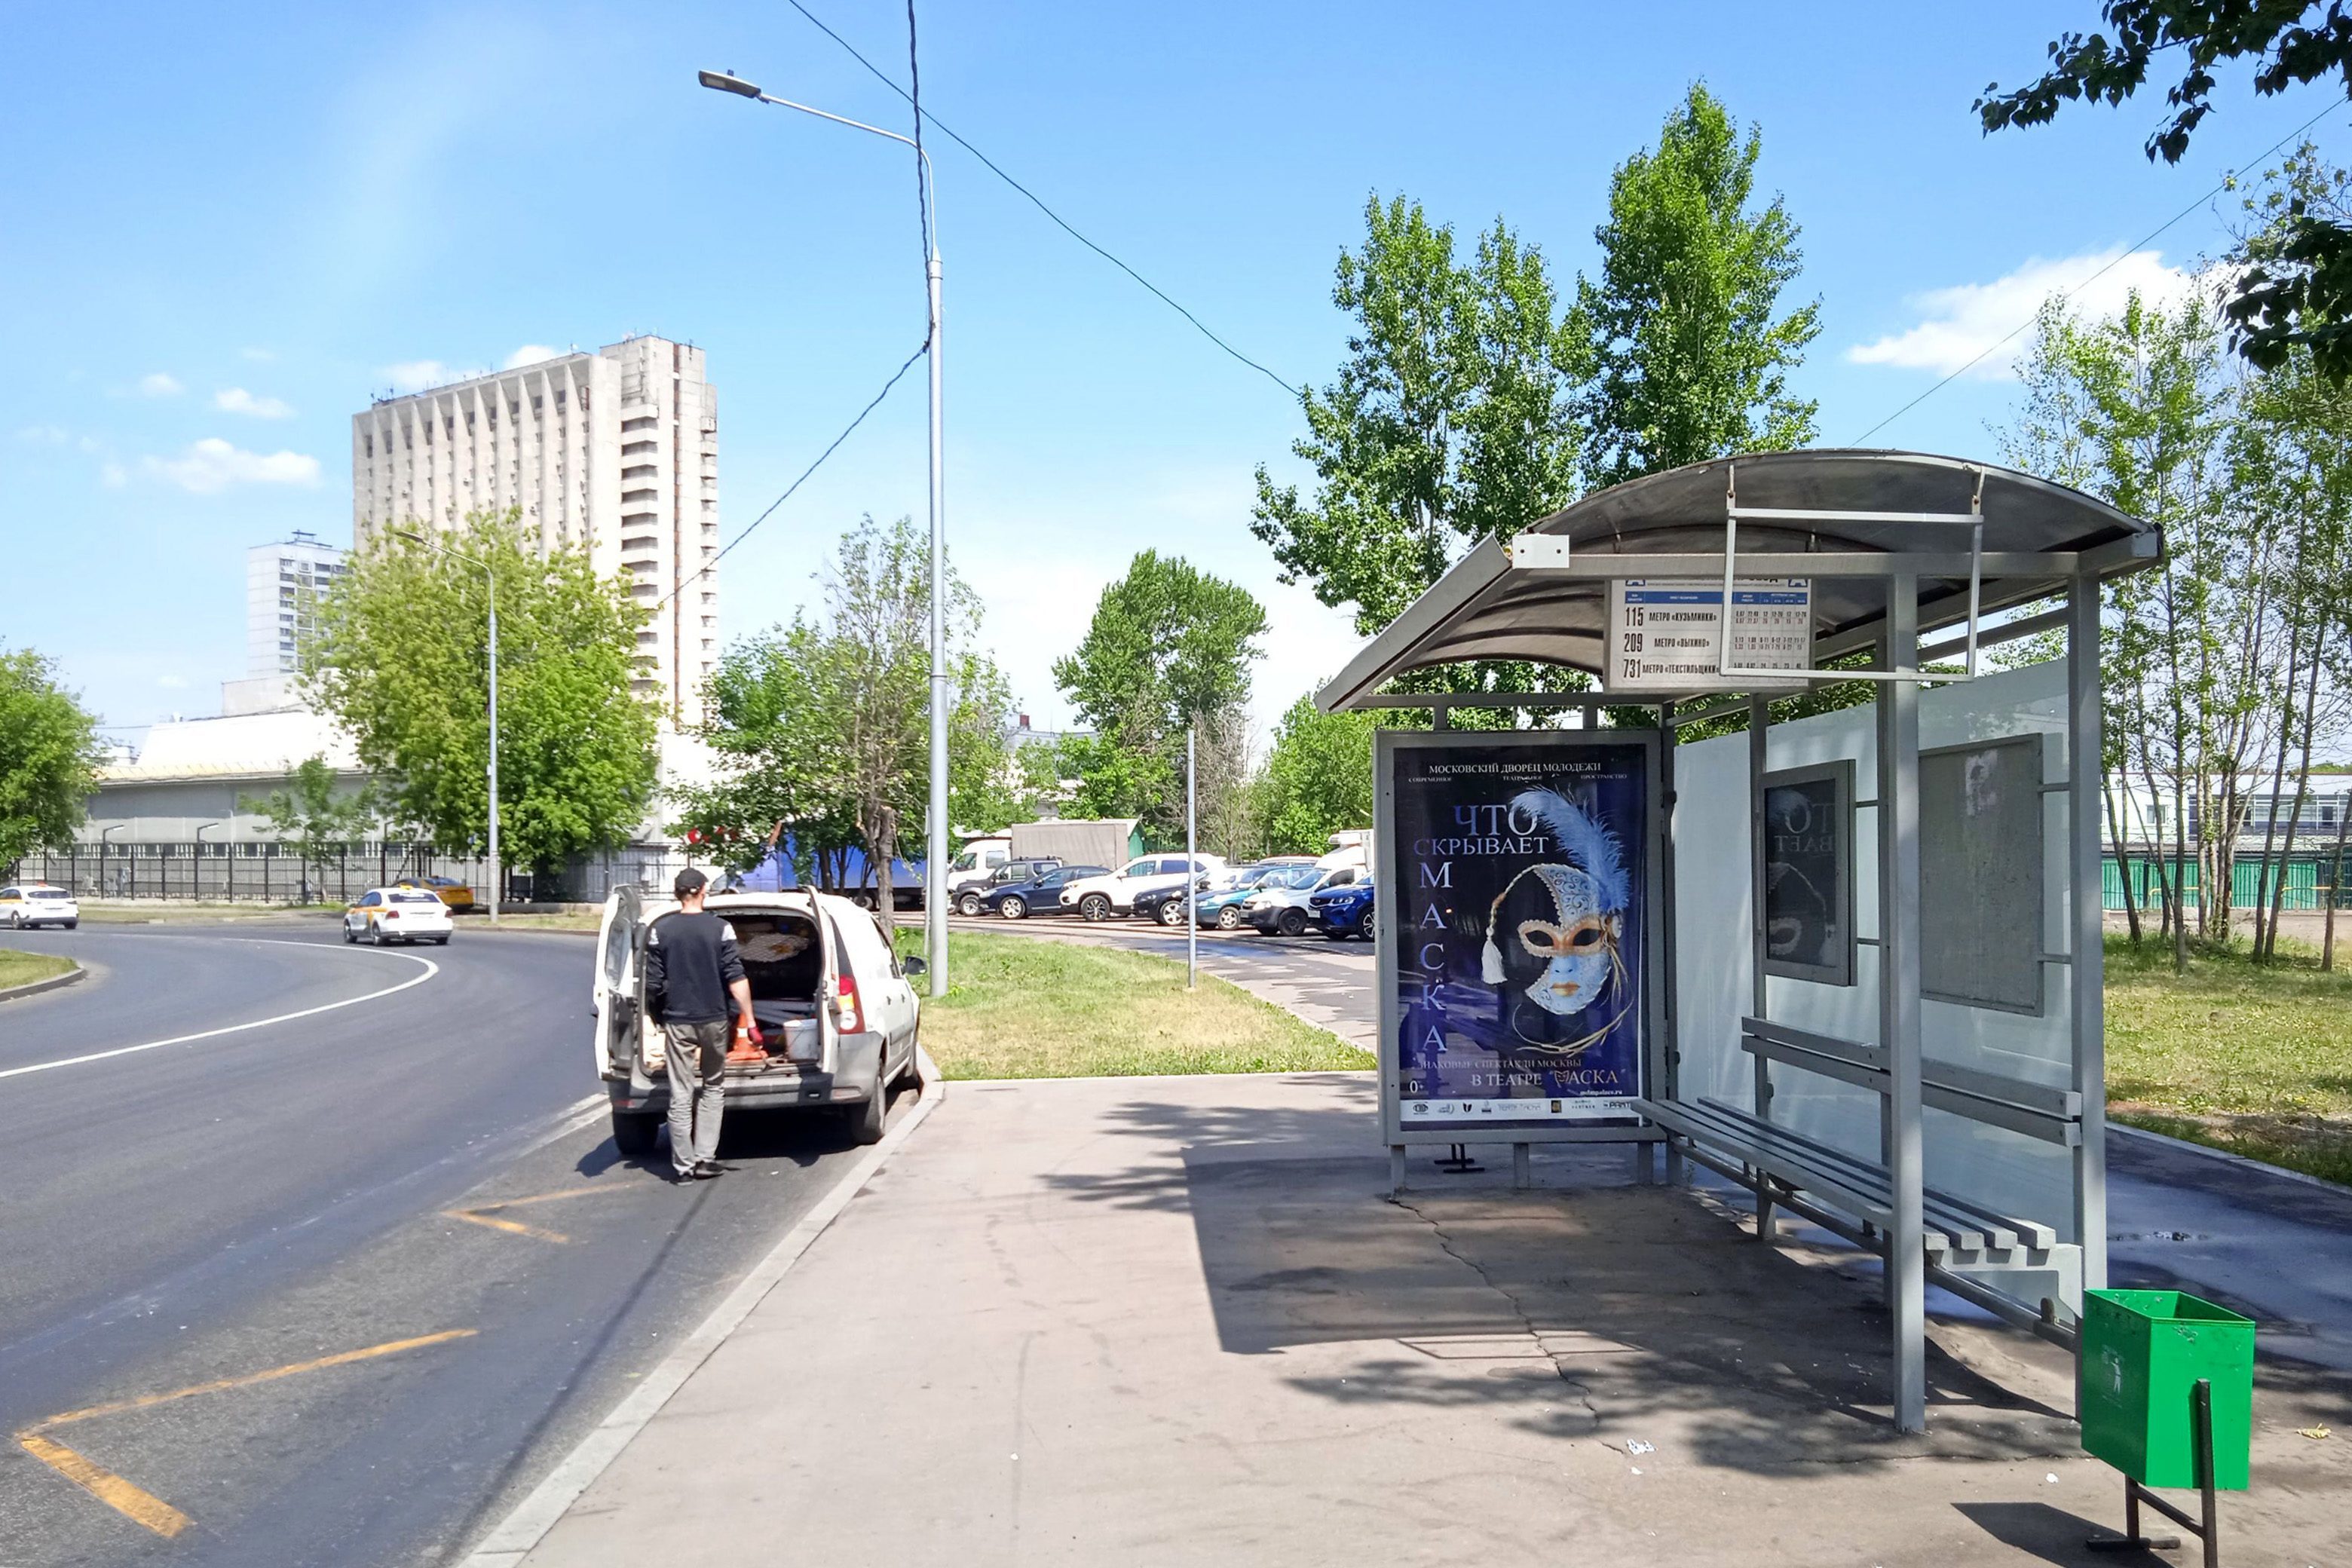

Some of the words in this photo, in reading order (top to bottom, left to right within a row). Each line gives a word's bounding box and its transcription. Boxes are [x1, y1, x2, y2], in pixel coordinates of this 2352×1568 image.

[1625, 607, 1644, 626] 115
[1649, 612, 1671, 622] МЕТРО
[1671, 612, 1717, 622] «КУЗЬМИНКИ»
[1624, 632, 1643, 652] 209
[1654, 638, 1676, 648] МЕТРО
[1677, 639, 1710, 648] «ВЫХИНО»
[1623, 659, 1642, 678] 731
[1643, 664, 1664, 673] МЕТРО
[1429, 763, 1499, 774] МОСКОВСКИЙ
[1500, 763, 1542, 773] ДВОРЕЦ
[1543, 762, 1601, 773] МОЛОДЕЖИ
[1453, 804, 1538, 837] ЧТО
[1413, 836, 1549, 856] СКРЫВАЕТ
[1537, 1058, 1582, 1068] МОСКВЫ
[1471, 1073, 1482, 1086] В
[1486, 1073, 1542, 1086] ТЕАТРЕ
